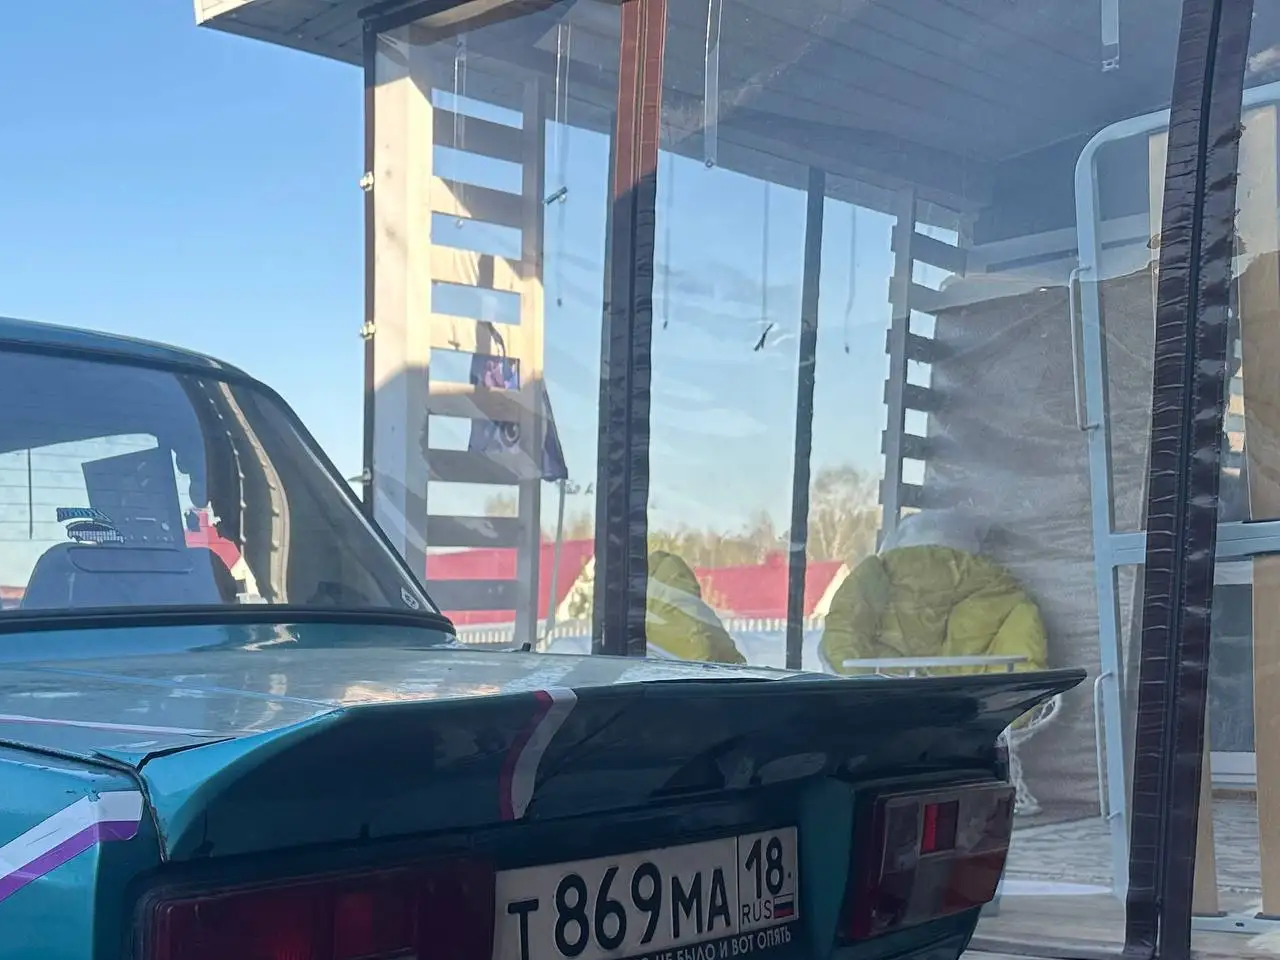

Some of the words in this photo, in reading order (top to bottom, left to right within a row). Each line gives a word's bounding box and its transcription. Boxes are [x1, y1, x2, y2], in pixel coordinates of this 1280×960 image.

[745, 837, 785, 899] 18
[741, 900, 772, 924] RUS
[720, 940, 728, 958] И
[732, 937, 754, 957] ВОТ
[757, 925, 792, 949] ОПЯТЬ
